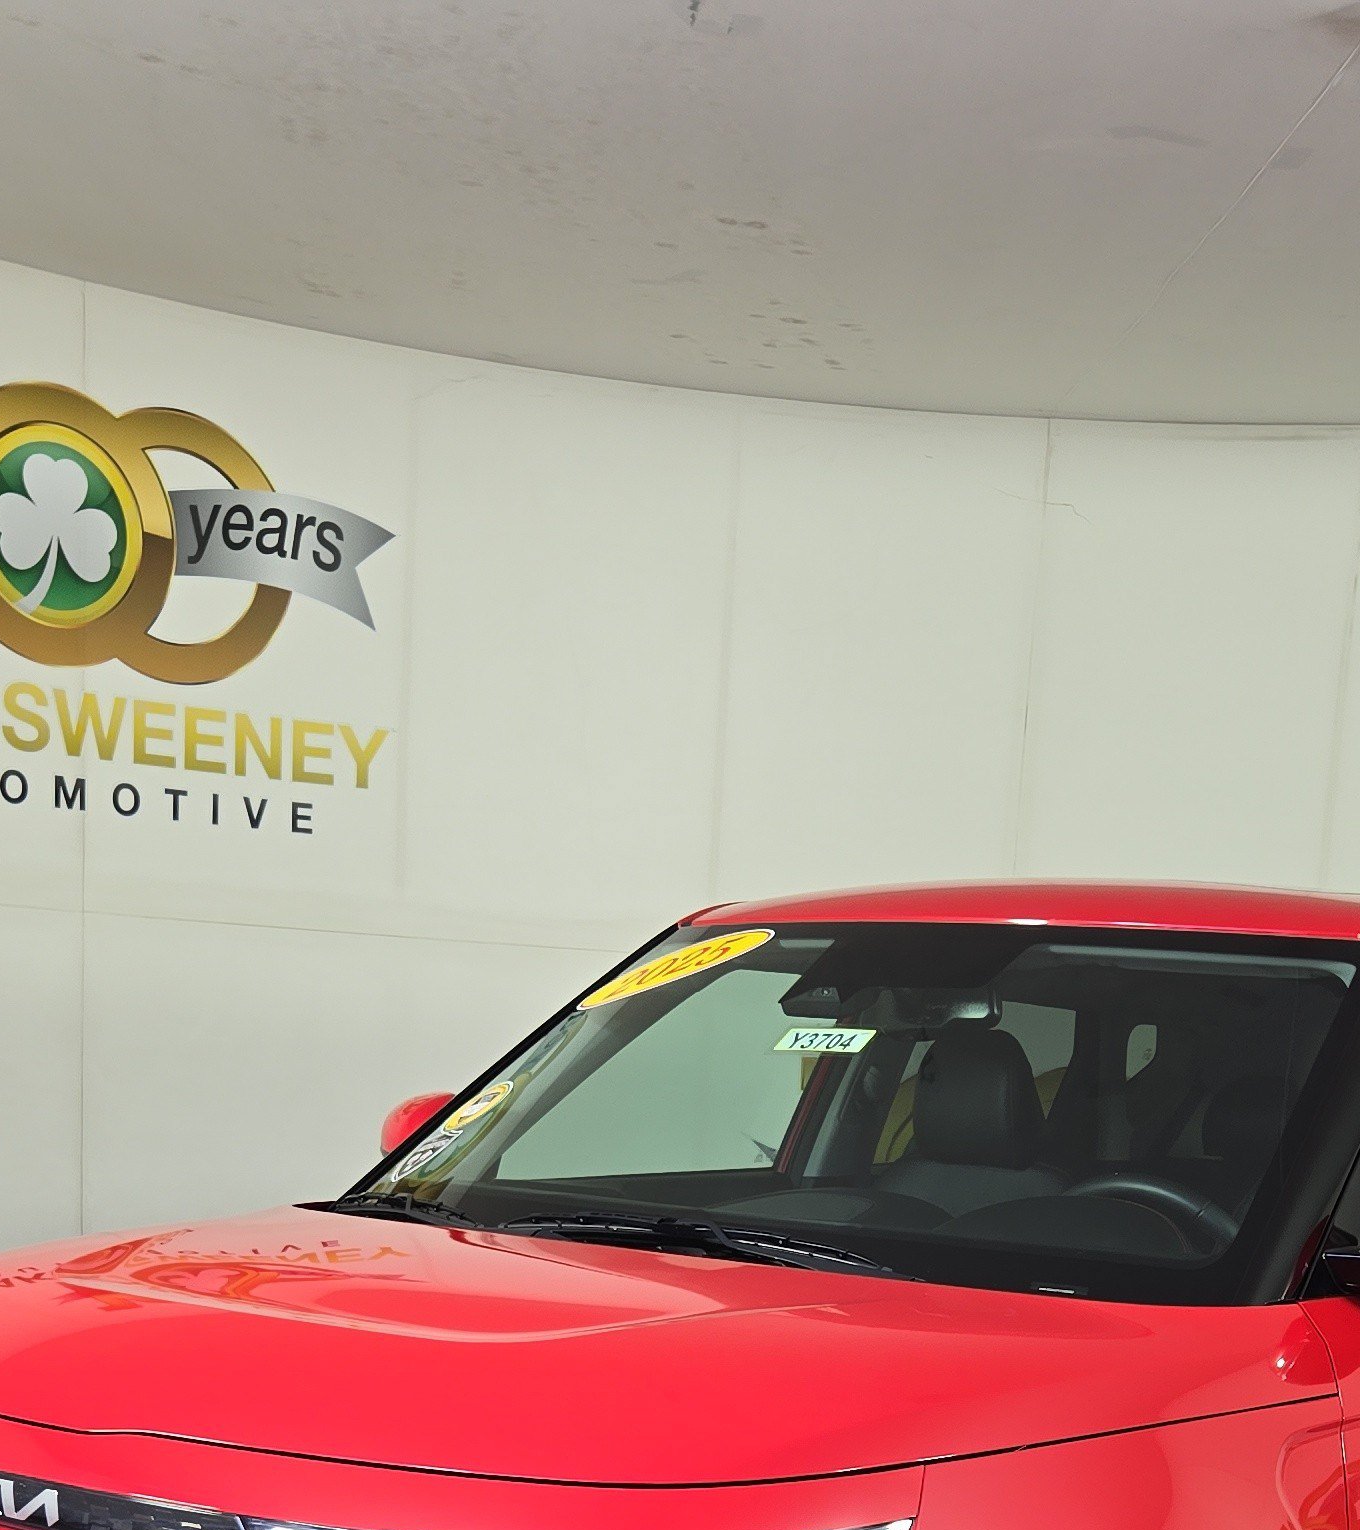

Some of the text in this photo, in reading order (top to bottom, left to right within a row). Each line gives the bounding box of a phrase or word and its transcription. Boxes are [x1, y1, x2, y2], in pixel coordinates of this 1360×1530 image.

[187, 502, 345, 572] years
[1, 681, 390, 790] SWEENEY
[603, 936, 745, 1000] 2025
[788, 1032, 857, 1050] Y3704
